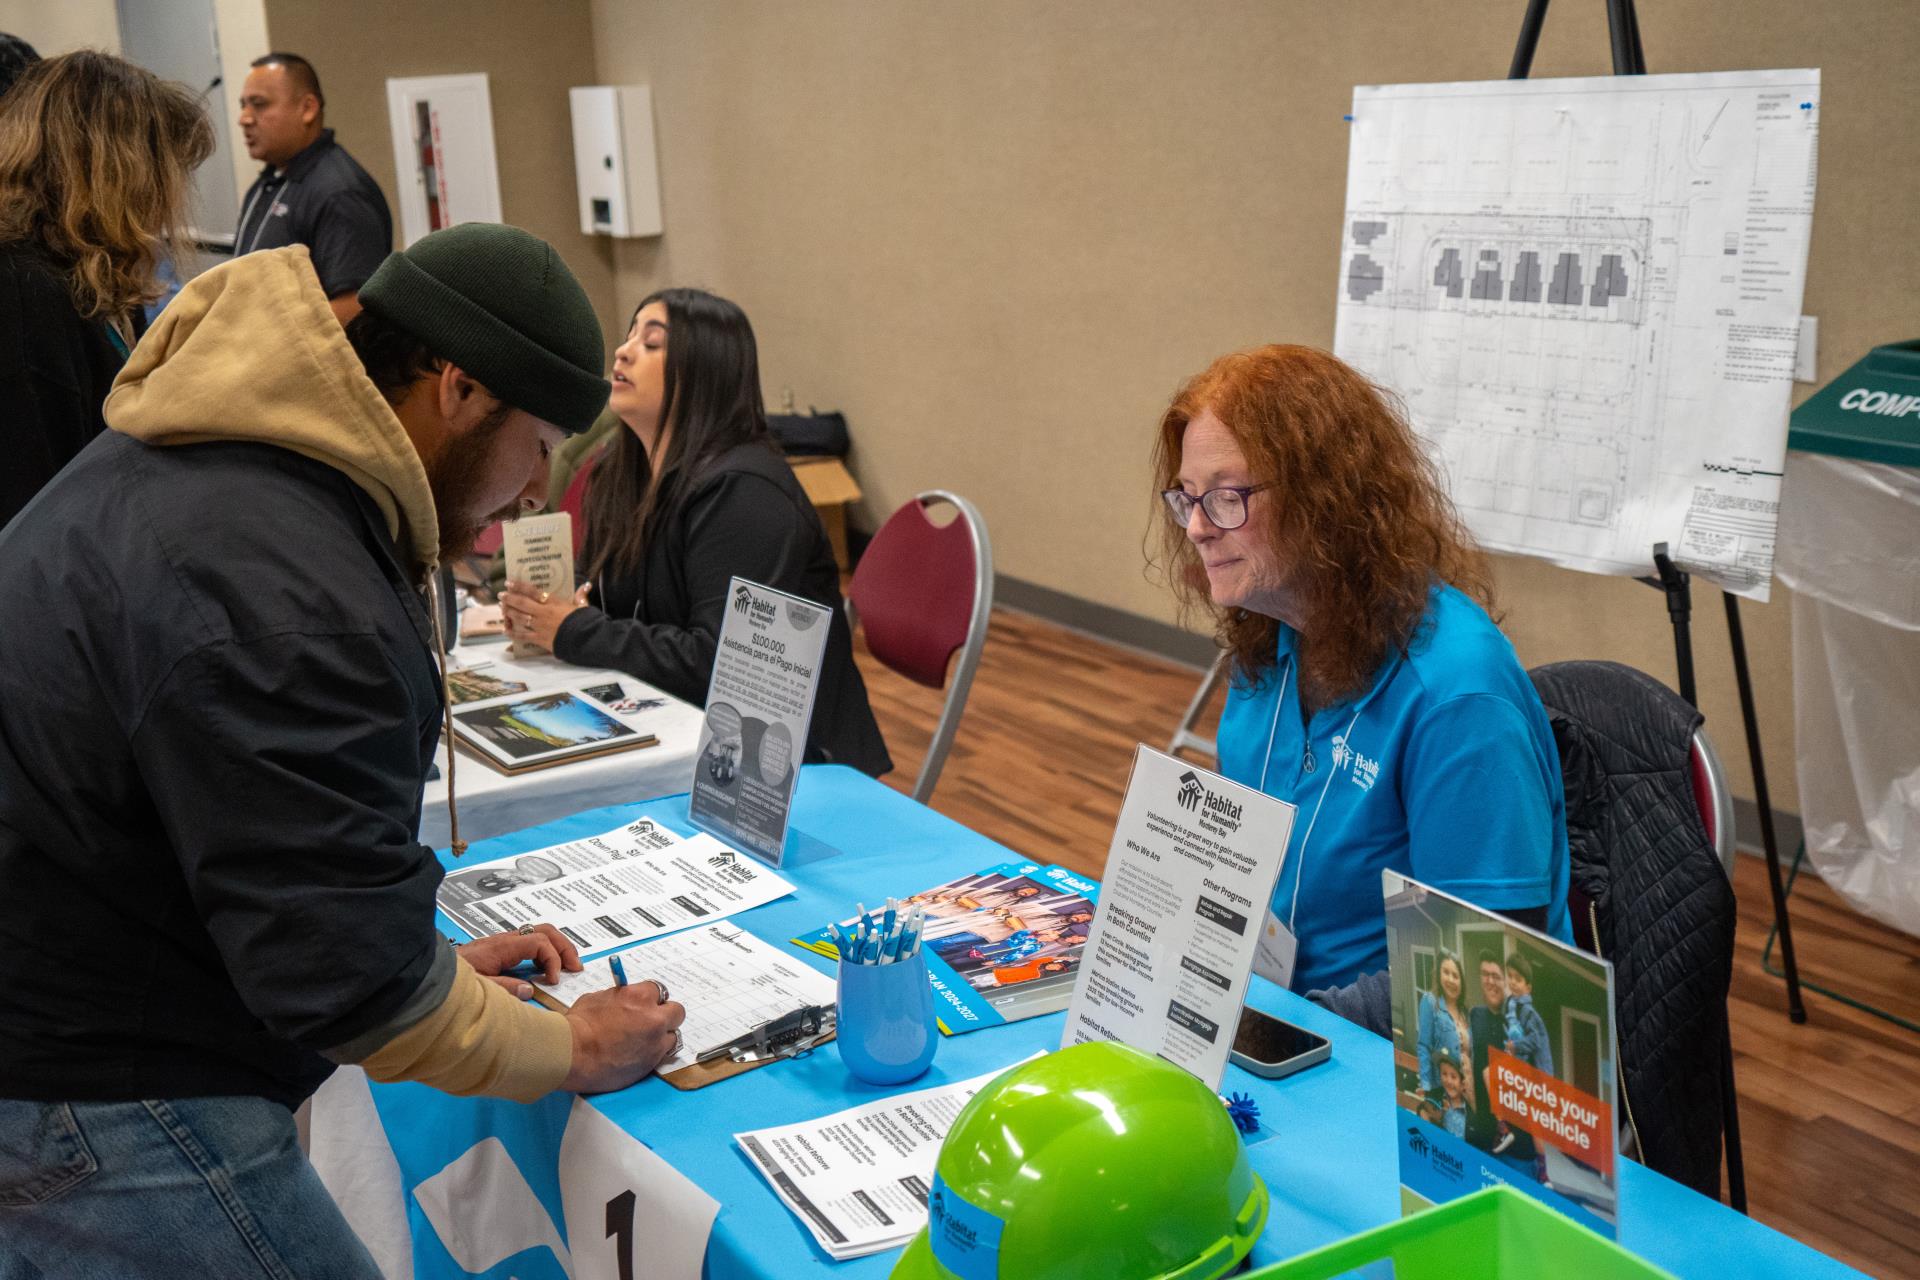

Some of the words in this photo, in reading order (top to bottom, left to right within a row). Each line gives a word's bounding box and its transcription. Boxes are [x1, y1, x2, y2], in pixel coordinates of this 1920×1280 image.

[752, 598, 776, 616] Habitat
[723, 637, 752, 655] Asistencia
[753, 650, 769, 662] para
[770, 655, 776, 664] el
[776, 656, 792, 672] Pago
[793, 664, 812, 678] Inicial
[1201, 808, 1210, 818] for
[1204, 791, 1242, 820] Habitat
[589, 838, 611, 851] Down
[1147, 811, 1178, 832] Volunteering
[1186, 831, 1202, 841] great
[1202, 838, 1213, 848] way
[1219, 846, 1232, 855] gain
[1233, 852, 1257, 866] valuable
[1218, 828, 1227, 838] Bay
[1127, 840, 1140, 852] Who
[1141, 846, 1150, 856] We
[1150, 852, 1160, 862] Are
[1147, 823, 1173, 838] experience
[1173, 835, 1184, 844] and
[1184, 840, 1205, 853] connect
[1205, 850, 1217, 859] with
[1217, 855, 1237, 869] Habitat
[1238, 865, 1252, 875] staff
[1184, 851, 1214, 870] community
[728, 864, 757, 881] Habitat
[701, 898, 720, 911] Programs
[1203, 878, 1220, 892] Other
[1221, 887, 1251, 907] Programs
[1109, 903, 1134, 924] Breaking
[1135, 917, 1156, 933] Ground
[1112, 917, 1125, 929] Both
[1126, 924, 1151, 943] Counties
[1096, 954, 1111, 967] families
[1105, 942, 1118, 953] homes
[1118, 949, 1136, 965] breaking
[1136, 960, 1152, 972] ground
[1106, 952, 1122, 964] summer
[1129, 965, 1153, 982] low-income
[1092, 969, 1105, 981] Marina
[1121, 987, 1135, 999] Marina
[1093, 979, 1106, 991] homes
[1106, 988, 1124, 1003] breaking
[1124, 999, 1139, 1011] ground
[940, 990, 979, 1021] 2024-2027
[1085, 993, 1101, 1006] families
[1111, 999, 1135, 1017] low-income
[1080, 1014, 1100, 1032] Habitat
[1498, 1065, 1557, 1109] recycle
[1559, 1098, 1598, 1129] your
[899, 1113, 912, 1123] Both
[910, 1123, 931, 1141] Counties
[904, 1105, 926, 1125] Breaking
[924, 1124, 943, 1139] Ground
[1499, 1085, 1528, 1117] idle
[1531, 1106, 1590, 1150] vehicle
[876, 1118, 887, 1129] homes
[885, 1129, 901, 1142] breaking
[897, 1142, 913, 1152] ground
[796, 1135, 813, 1151] Habitat
[810, 1151, 829, 1170] ReStores
[1432, 1144, 1463, 1175] Habitat
